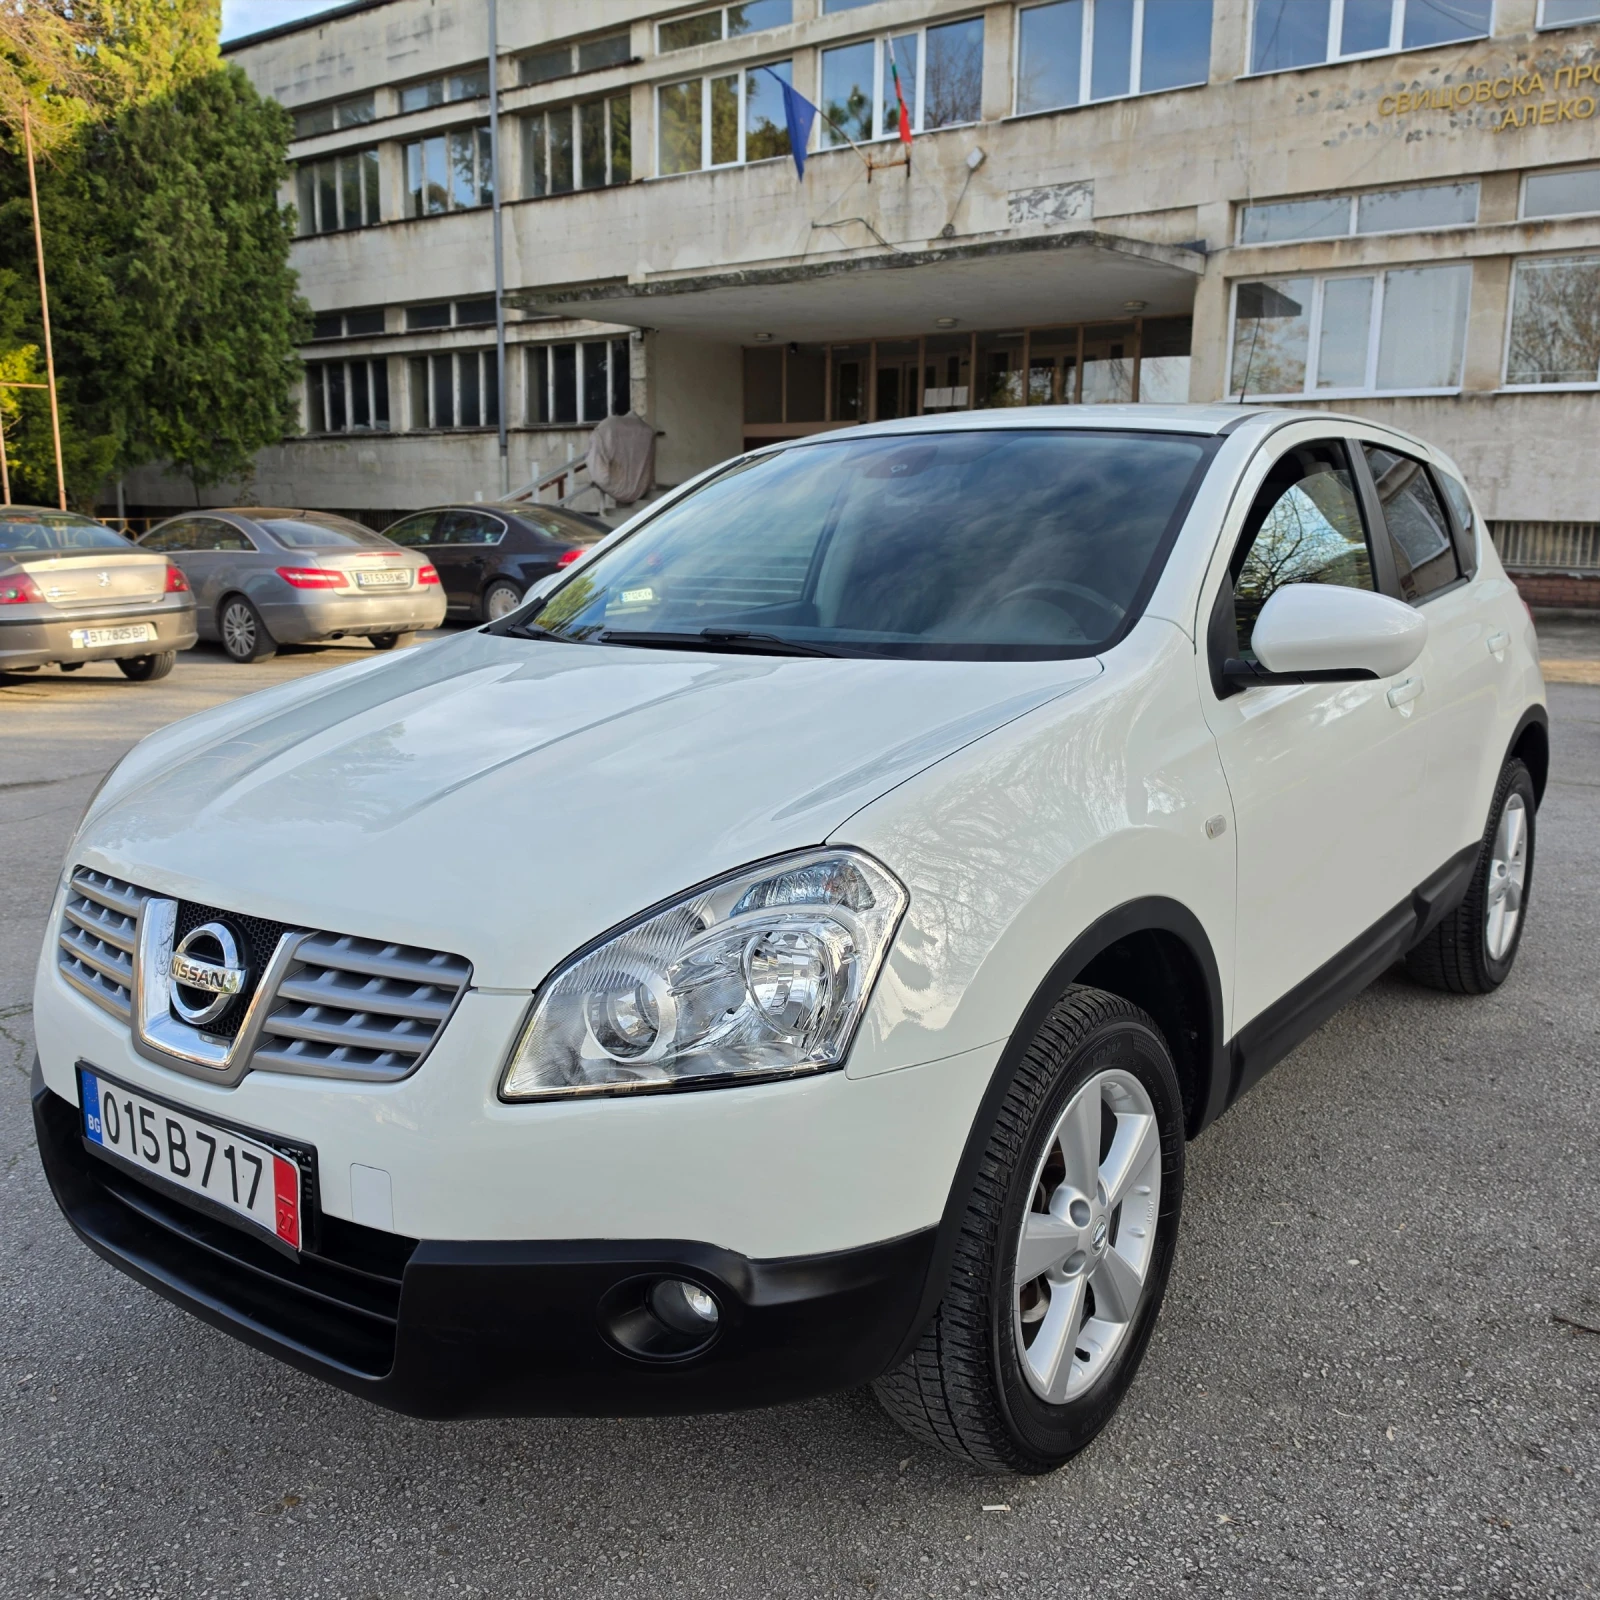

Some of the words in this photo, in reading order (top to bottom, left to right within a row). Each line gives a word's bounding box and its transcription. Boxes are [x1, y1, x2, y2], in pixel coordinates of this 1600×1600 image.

[1377, 73, 1545, 117] СВИЩОВСКА
[171, 959, 226, 988] NISSAN
[87, 1113, 101, 1134] BG
[103, 1091, 263, 1211] 015B717
[278, 1209, 294, 1234] 27
